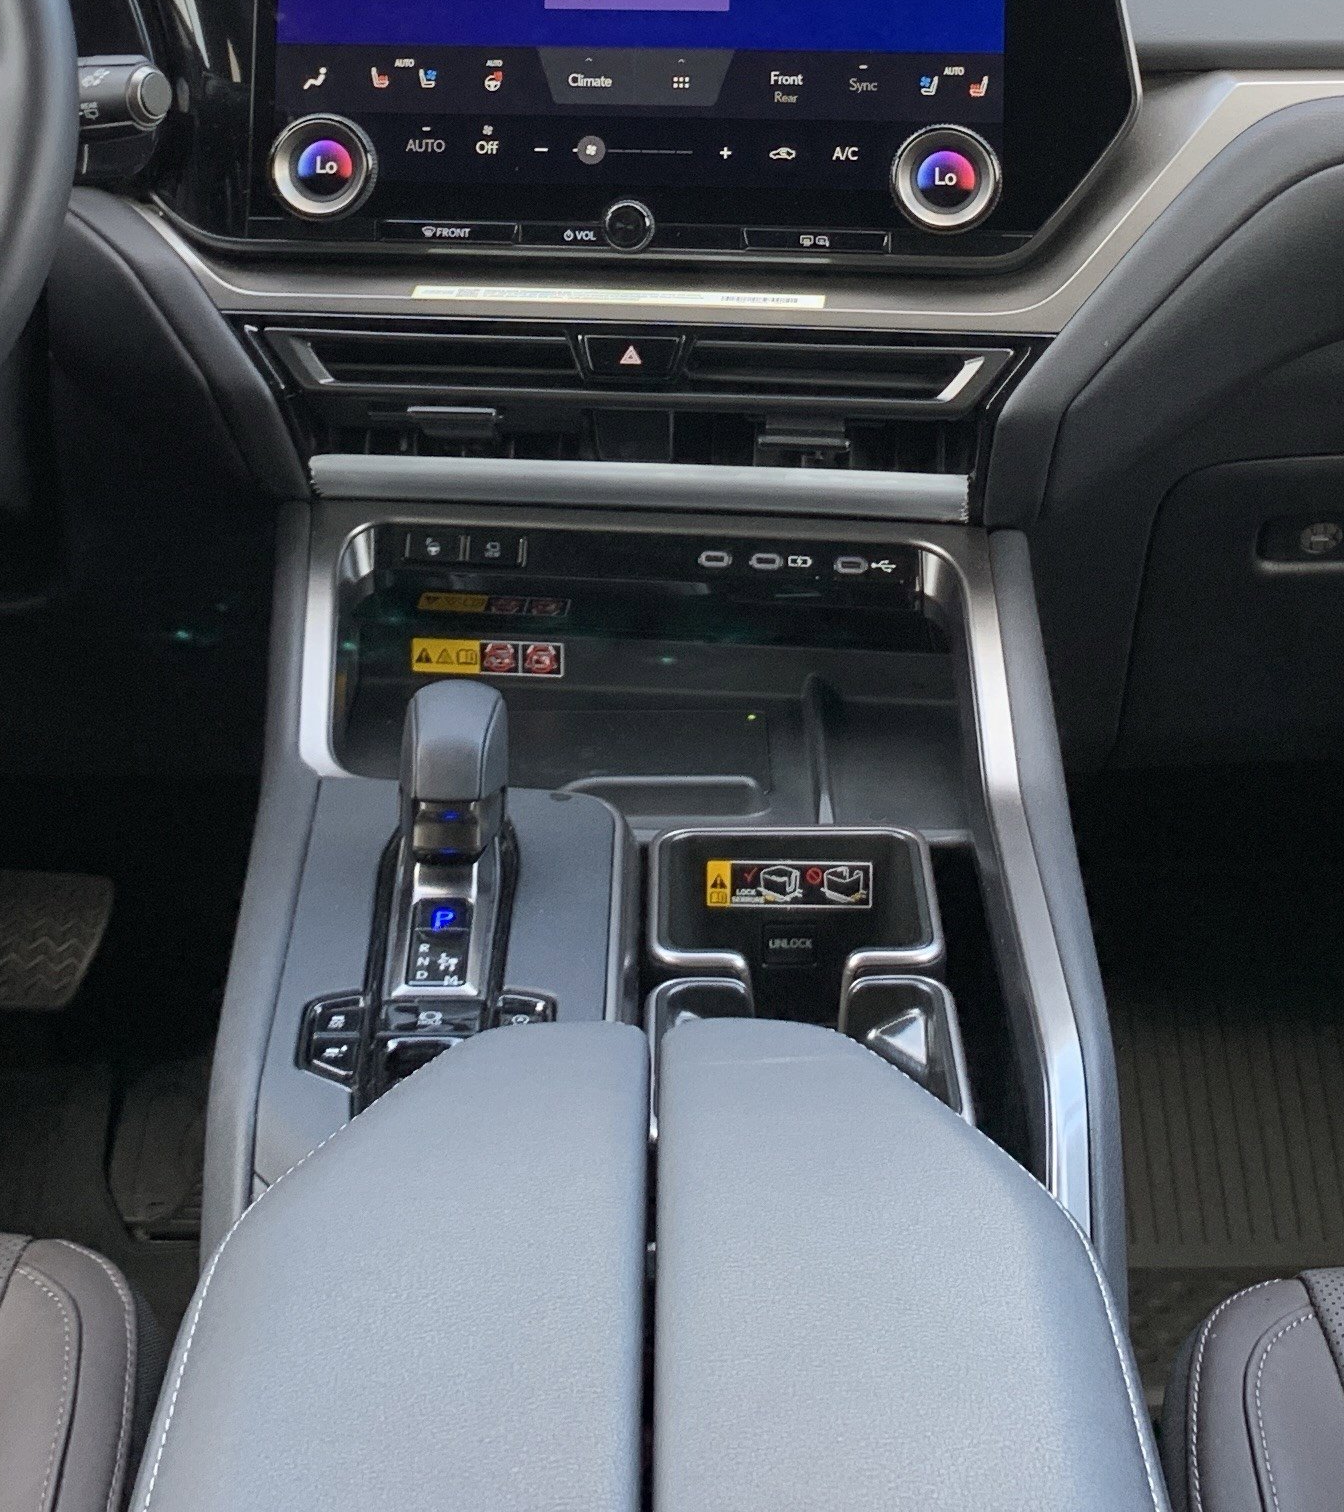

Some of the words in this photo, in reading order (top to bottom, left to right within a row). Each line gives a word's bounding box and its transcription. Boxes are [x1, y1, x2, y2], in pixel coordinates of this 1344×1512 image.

[394, 58, 415, 68] AUTO
[485, 59, 504, 68] AUTO
[942, 66, 965, 76] AUTO
[567, 72, 613, 88] Climate
[769, 71, 804, 86] Front
[848, 78, 879, 94] Sync
[773, 91, 799, 104] Rear
[405, 138, 446, 154] AUTO
[475, 140, 500, 156] Off
[832, 146, 859, 162] A/C
[314, 155, 339, 175] Lo
[933, 166, 958, 187] Lo
[435, 227, 472, 239] FRONT
[574, 229, 597, 241] VOL
[735, 888, 757, 896] LOCK
[431, 910, 455, 932] P
[418, 942, 431, 953] R
[768, 937, 814, 949] UNLOCK
[416, 955, 431, 966] N
[415, 969, 429, 980] D
